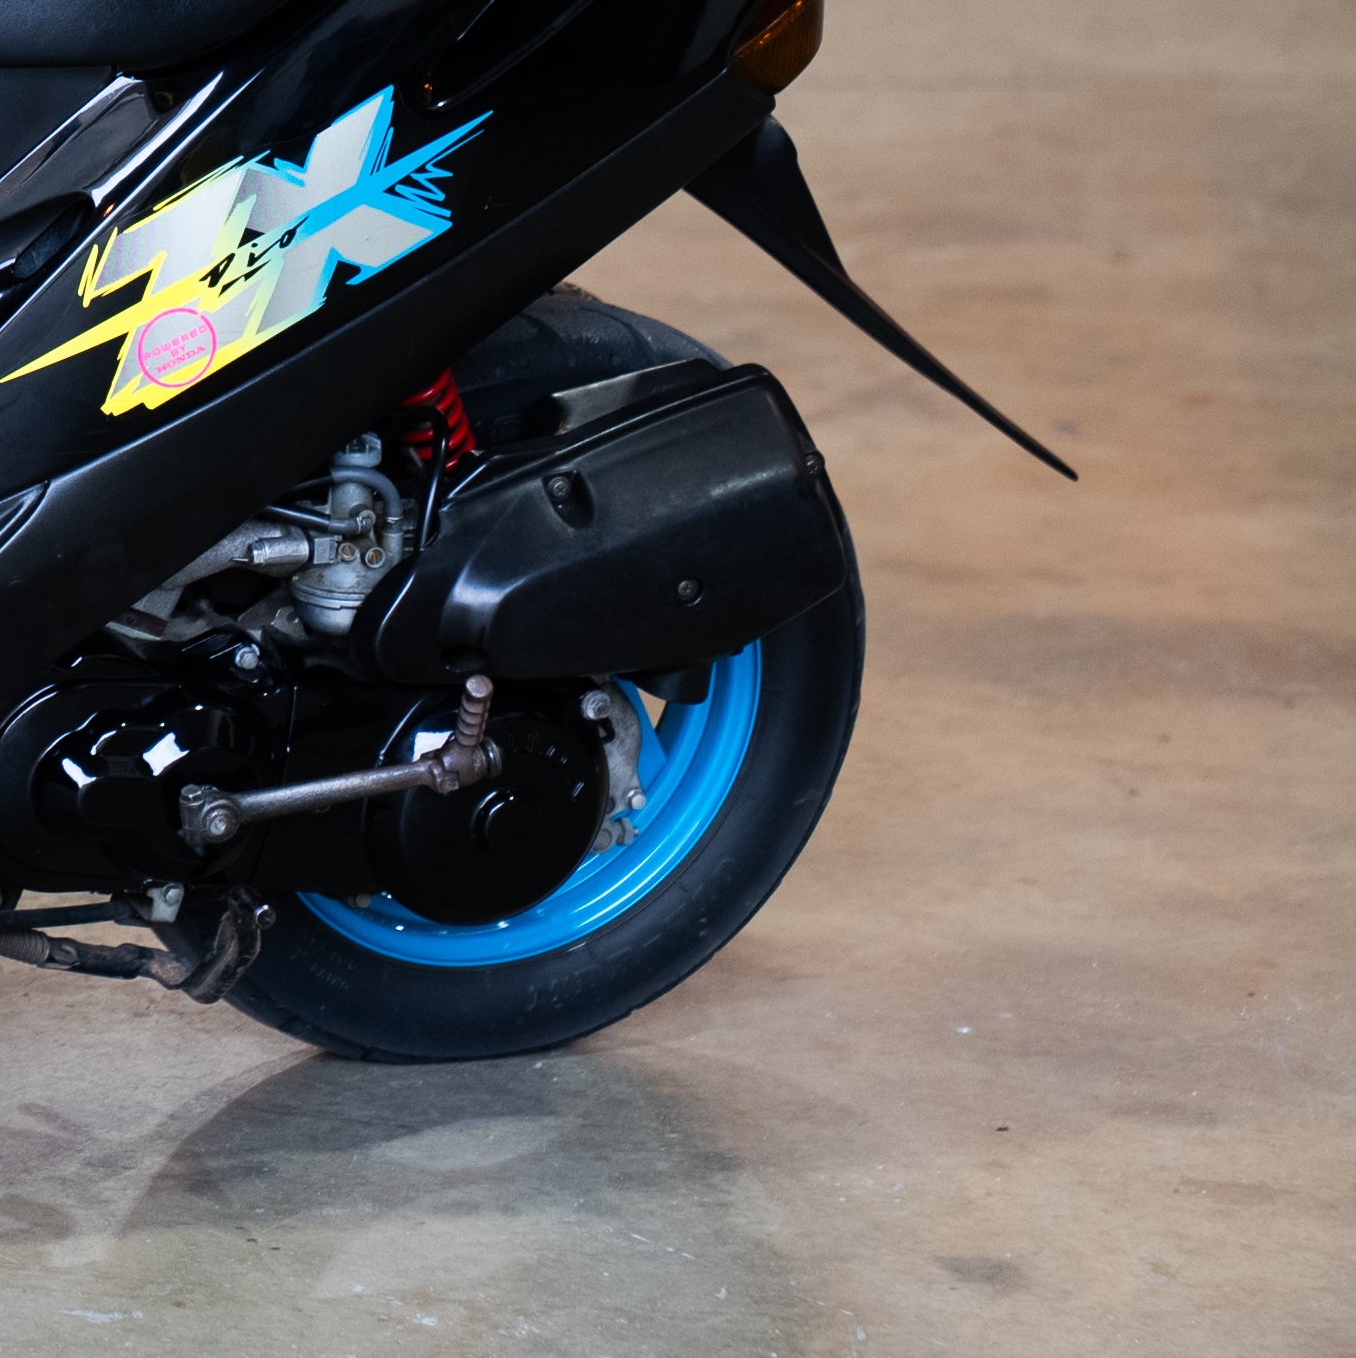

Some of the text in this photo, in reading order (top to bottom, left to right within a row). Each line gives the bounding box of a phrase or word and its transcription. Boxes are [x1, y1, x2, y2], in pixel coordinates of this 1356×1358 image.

[74, 84, 454, 416] ZX
[142, 324, 208, 362] POWERED
[155, 345, 206, 374] HONDA
[169, 344, 187, 358] BY
